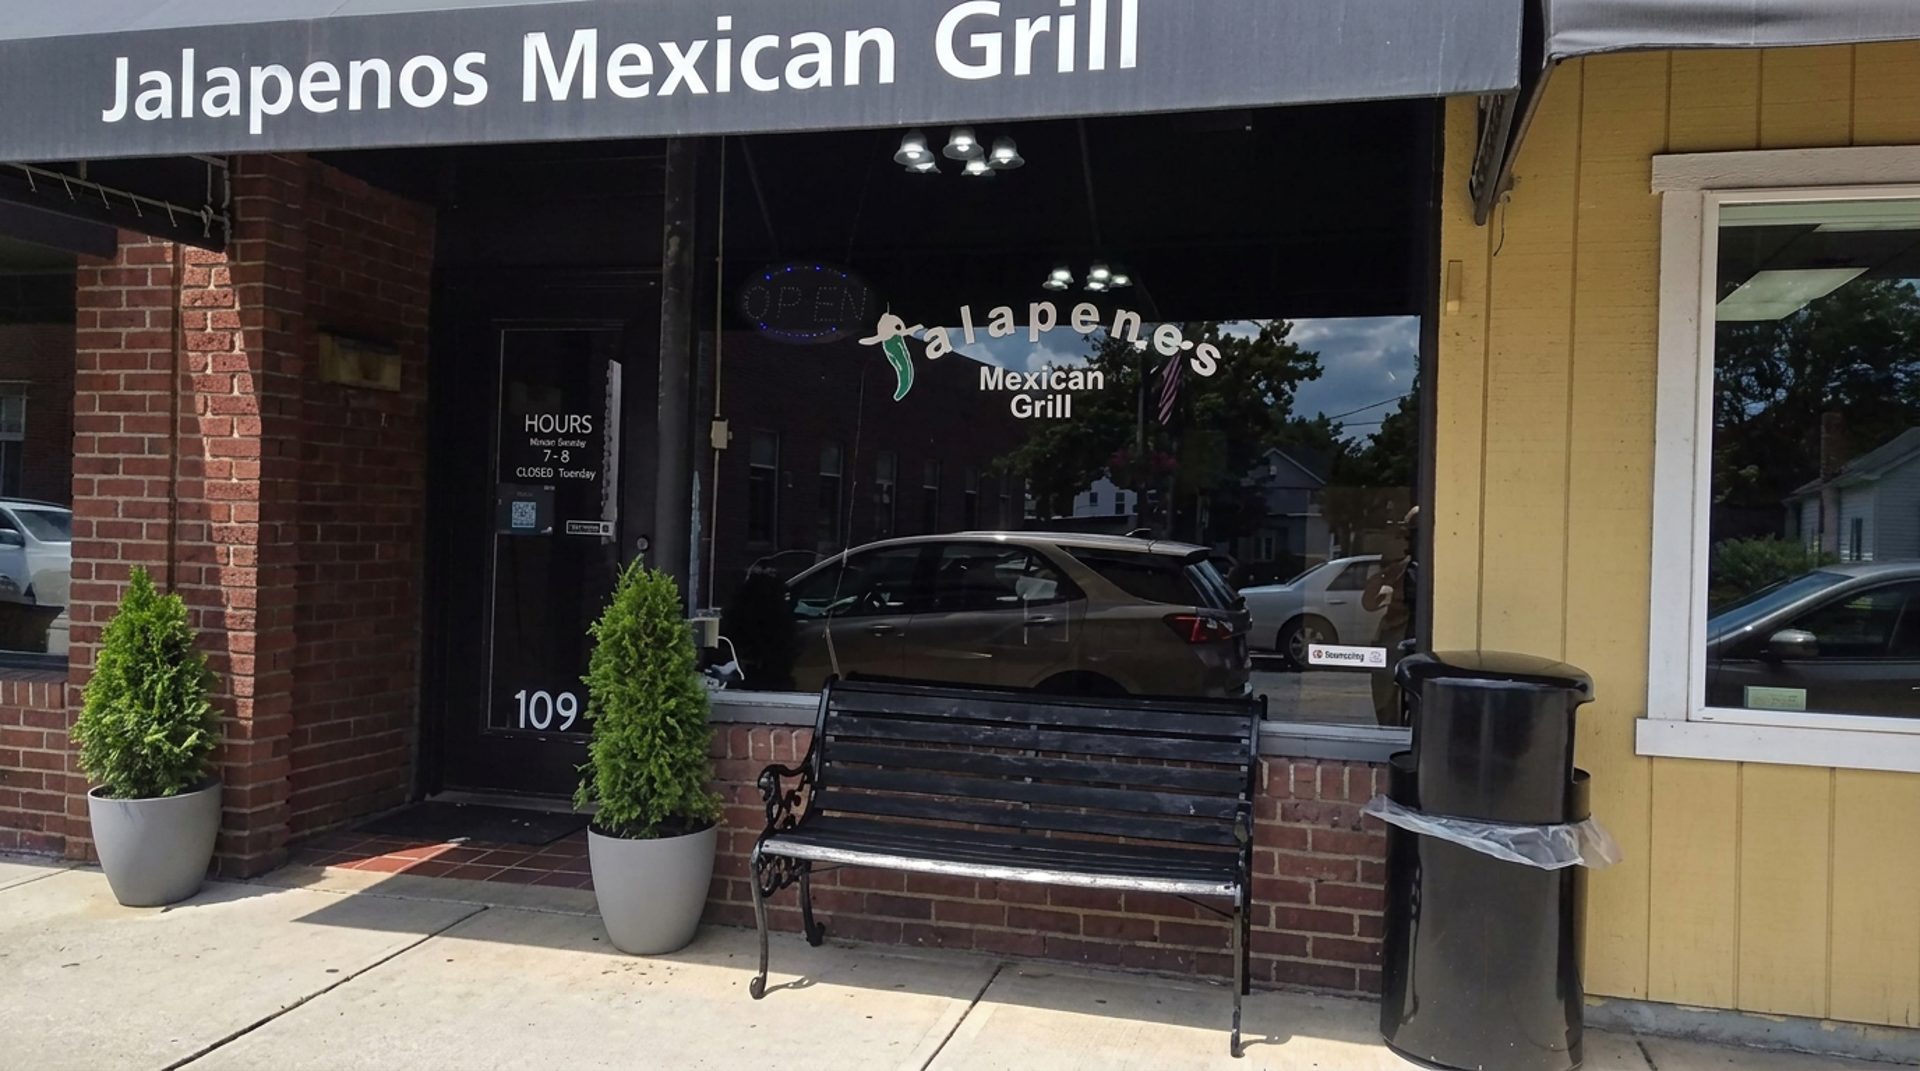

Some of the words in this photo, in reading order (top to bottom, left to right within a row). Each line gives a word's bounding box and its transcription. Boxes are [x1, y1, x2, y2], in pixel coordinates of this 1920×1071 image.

[101, 47, 489, 136] Jalapenos
[522, 15, 896, 103] Mexican
[935, 0, 1138, 80] Grill
[743, 285, 868, 322] OPEN
[980, 366, 1105, 391] Mexican
[1010, 394, 1072, 419] Grill
[525, 413, 593, 434] HOURS
[516, 466, 554, 478] CLOSED
[514, 689, 578, 731] 109
